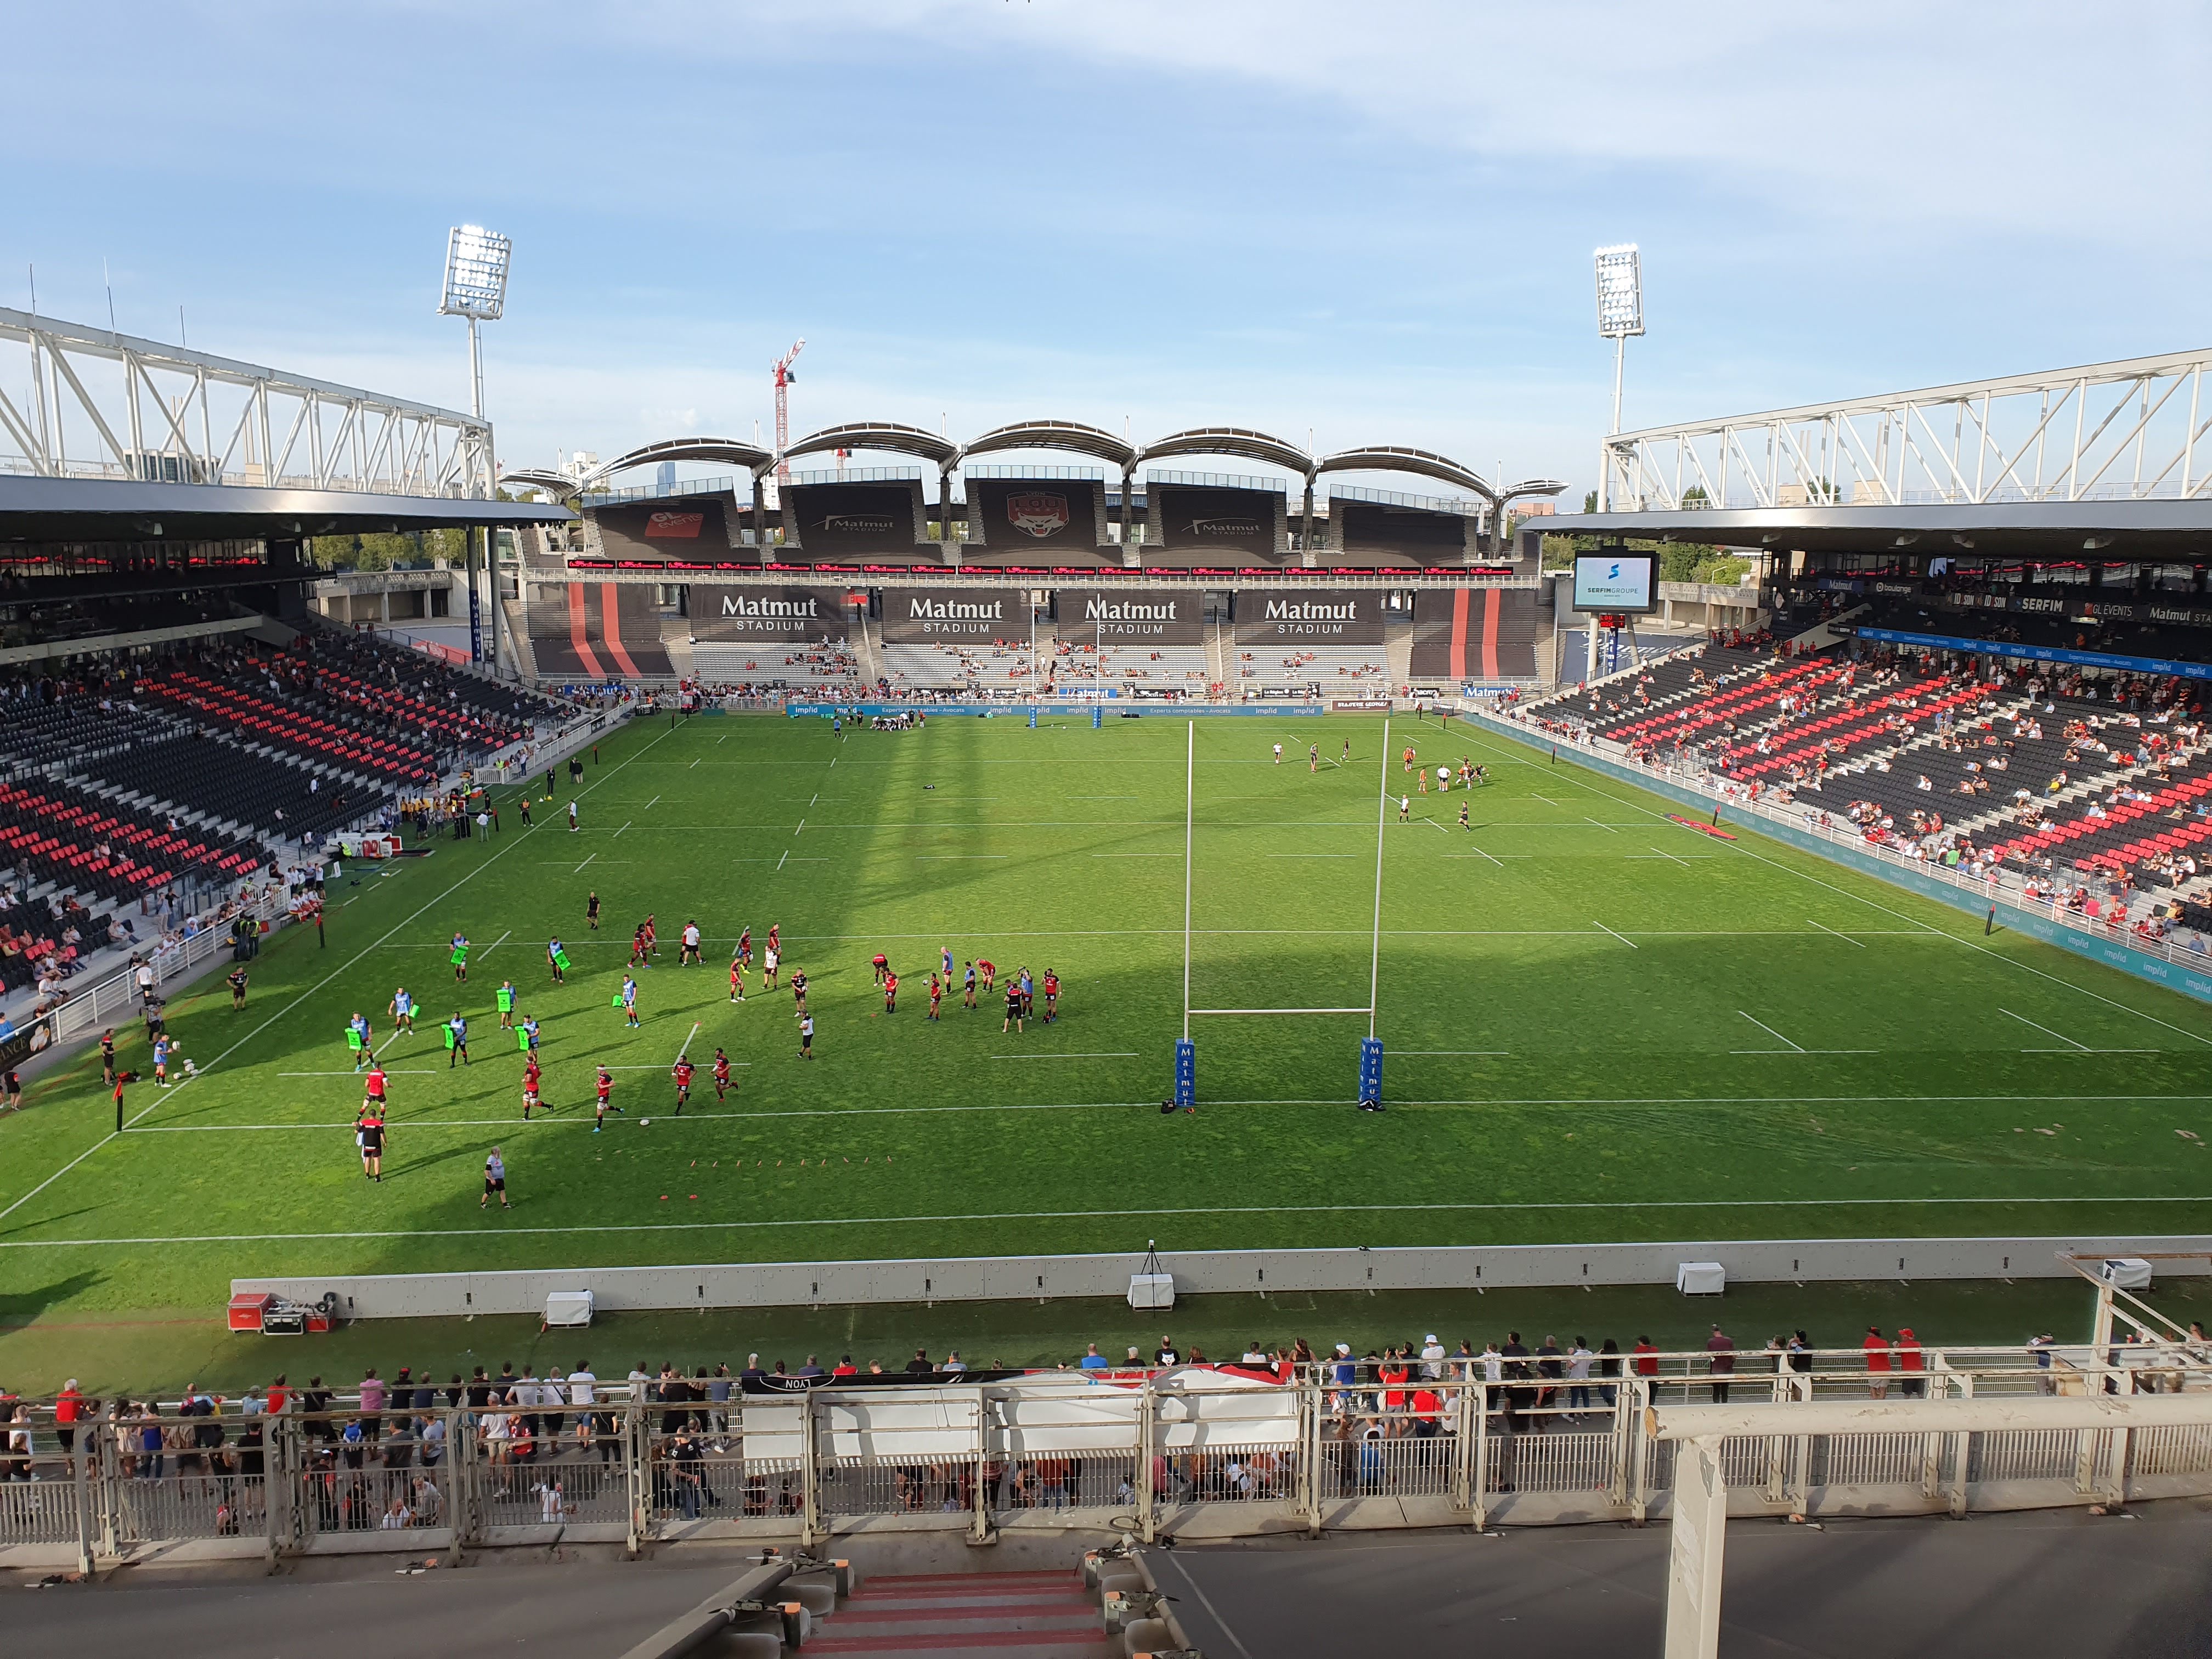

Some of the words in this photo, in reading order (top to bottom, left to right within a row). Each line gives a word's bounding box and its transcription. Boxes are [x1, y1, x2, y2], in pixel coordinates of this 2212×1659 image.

[1014, 497, 1060, 508] LOU
[651, 512, 681, 522] GL
[658, 514, 703, 528] events
[1829, 579, 1853, 590] Matmut
[722, 595, 817, 617] Matmut
[910, 598, 1003, 618] Matmut
[1085, 600, 1177, 619] Matmut
[1265, 600, 1357, 619] Matmut
[2022, 598, 2063, 612] SERFIM
[2093, 604, 2102, 614] GL
[2103, 605, 2133, 616] EVENTS
[2149, 607, 2191, 621] Matmut
[737, 620, 804, 631] STADIUM
[923, 623, 989, 633] STADIUM
[1099, 624, 1163, 634] STADIUM
[1278, 624, 1342, 634] STADIUM
[1181, 1048, 1190, 1105] Matmut
[1369, 1046, 1379, 1094] Matmu
[786, 1379, 811, 1389] LYON
